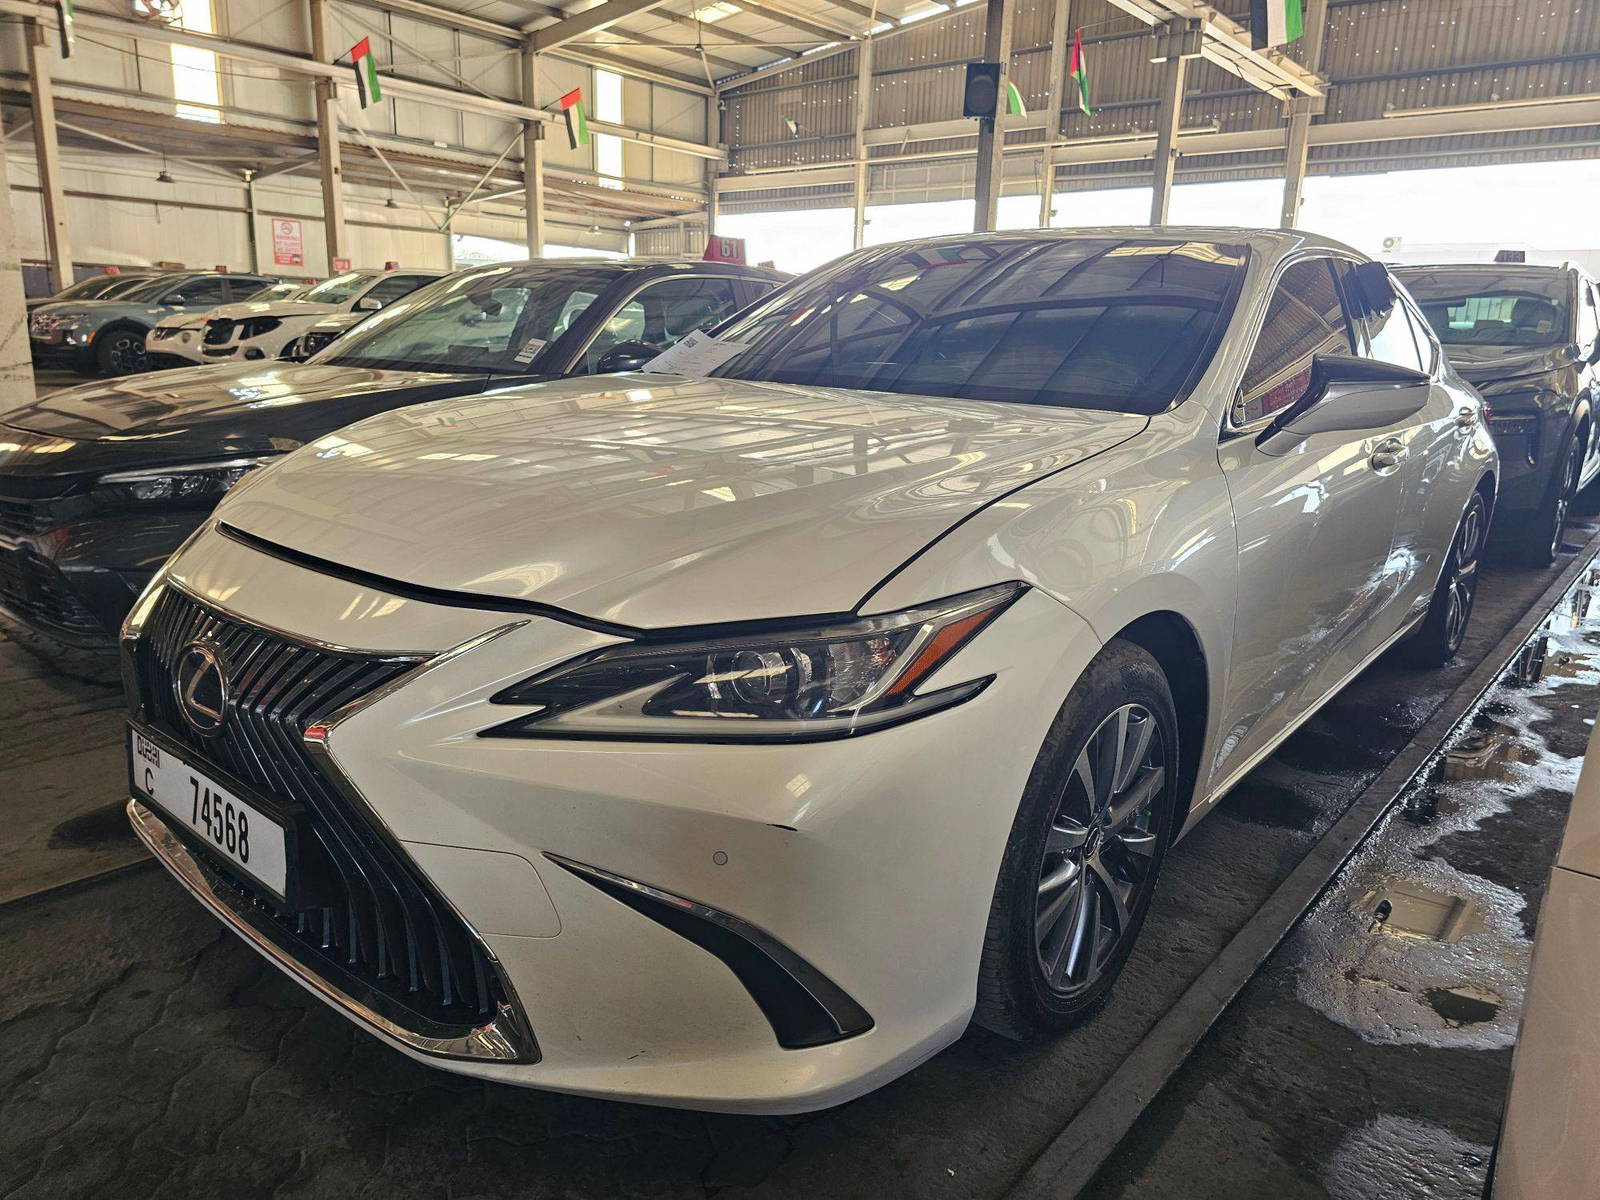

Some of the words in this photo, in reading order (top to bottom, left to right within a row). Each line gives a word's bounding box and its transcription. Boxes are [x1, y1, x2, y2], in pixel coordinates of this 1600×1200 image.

[720, 238, 738, 257] 61
[145, 767, 154, 795] C
[190, 775, 249, 864] 74568
